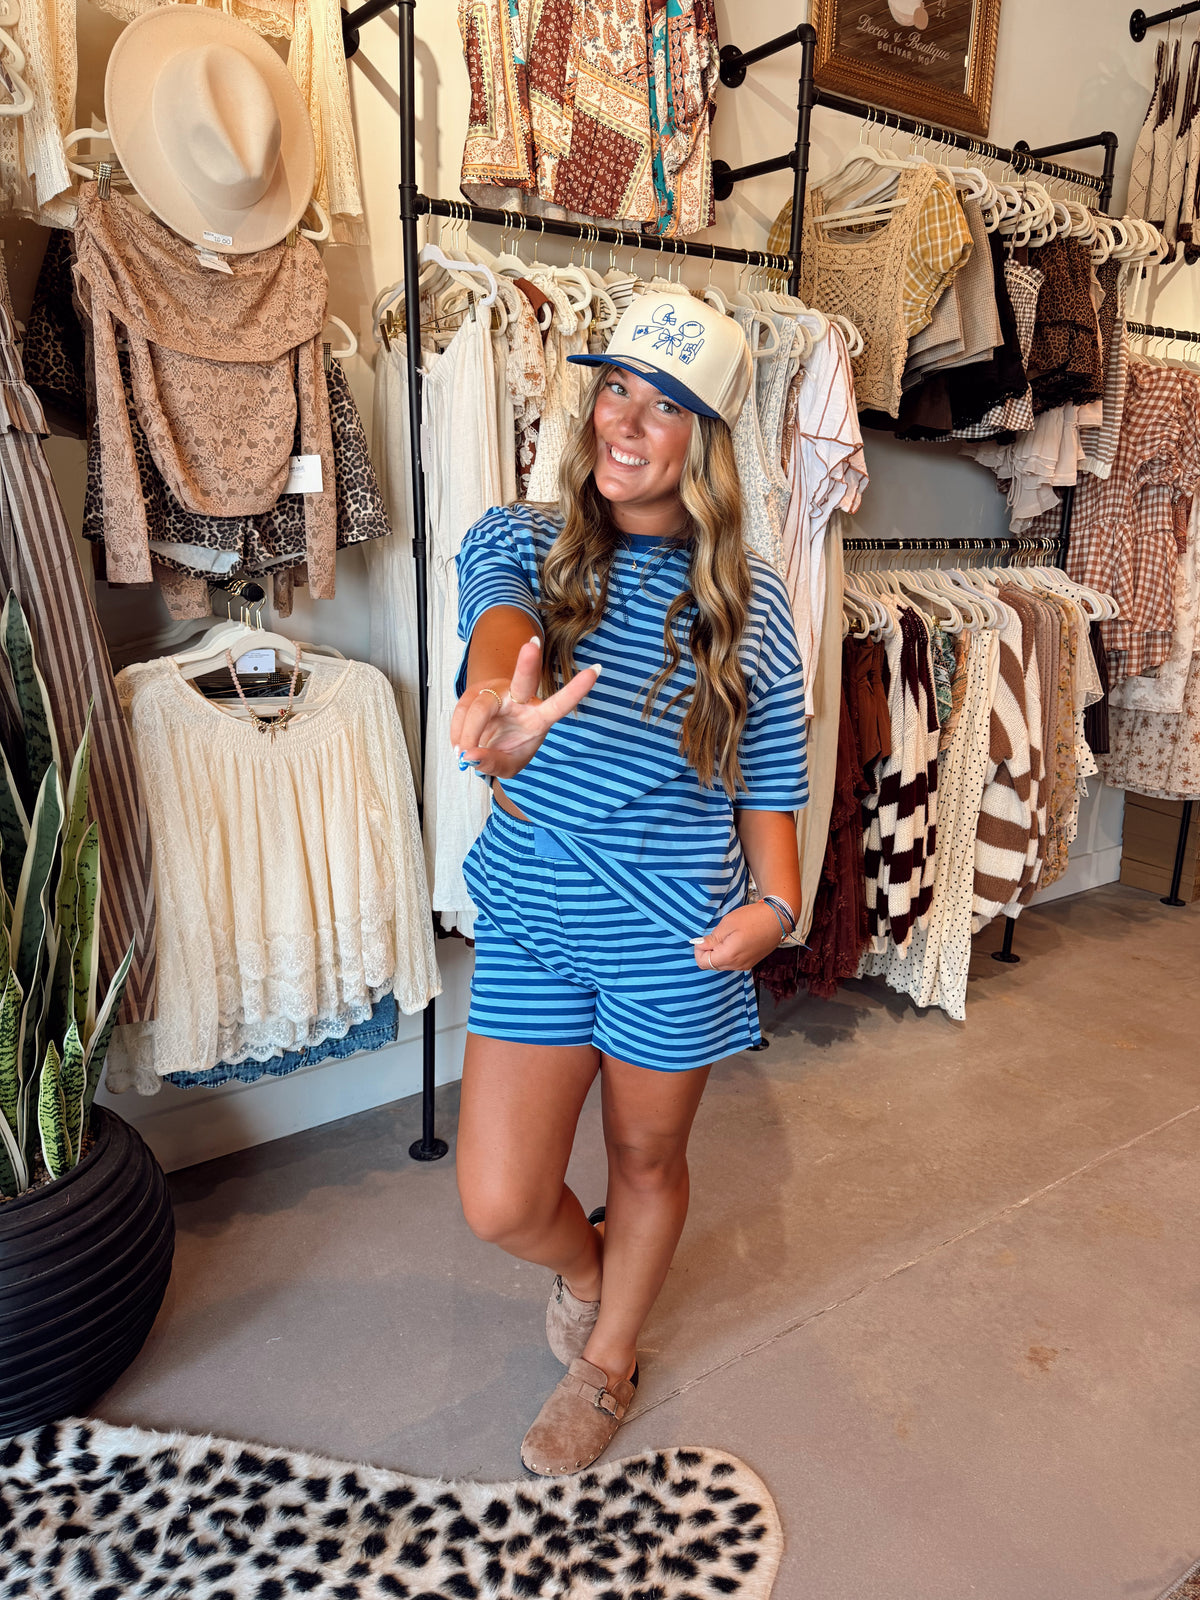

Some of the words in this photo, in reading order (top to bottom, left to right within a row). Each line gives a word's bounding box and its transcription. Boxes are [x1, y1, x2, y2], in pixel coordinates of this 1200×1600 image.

[856, 14, 889, 39] Decor
[894, 32, 902, 42] &
[905, 31, 951, 64] Boutique
[877, 40, 915, 62] BOLIVAR,
[918, 55, 930, 66] MO
